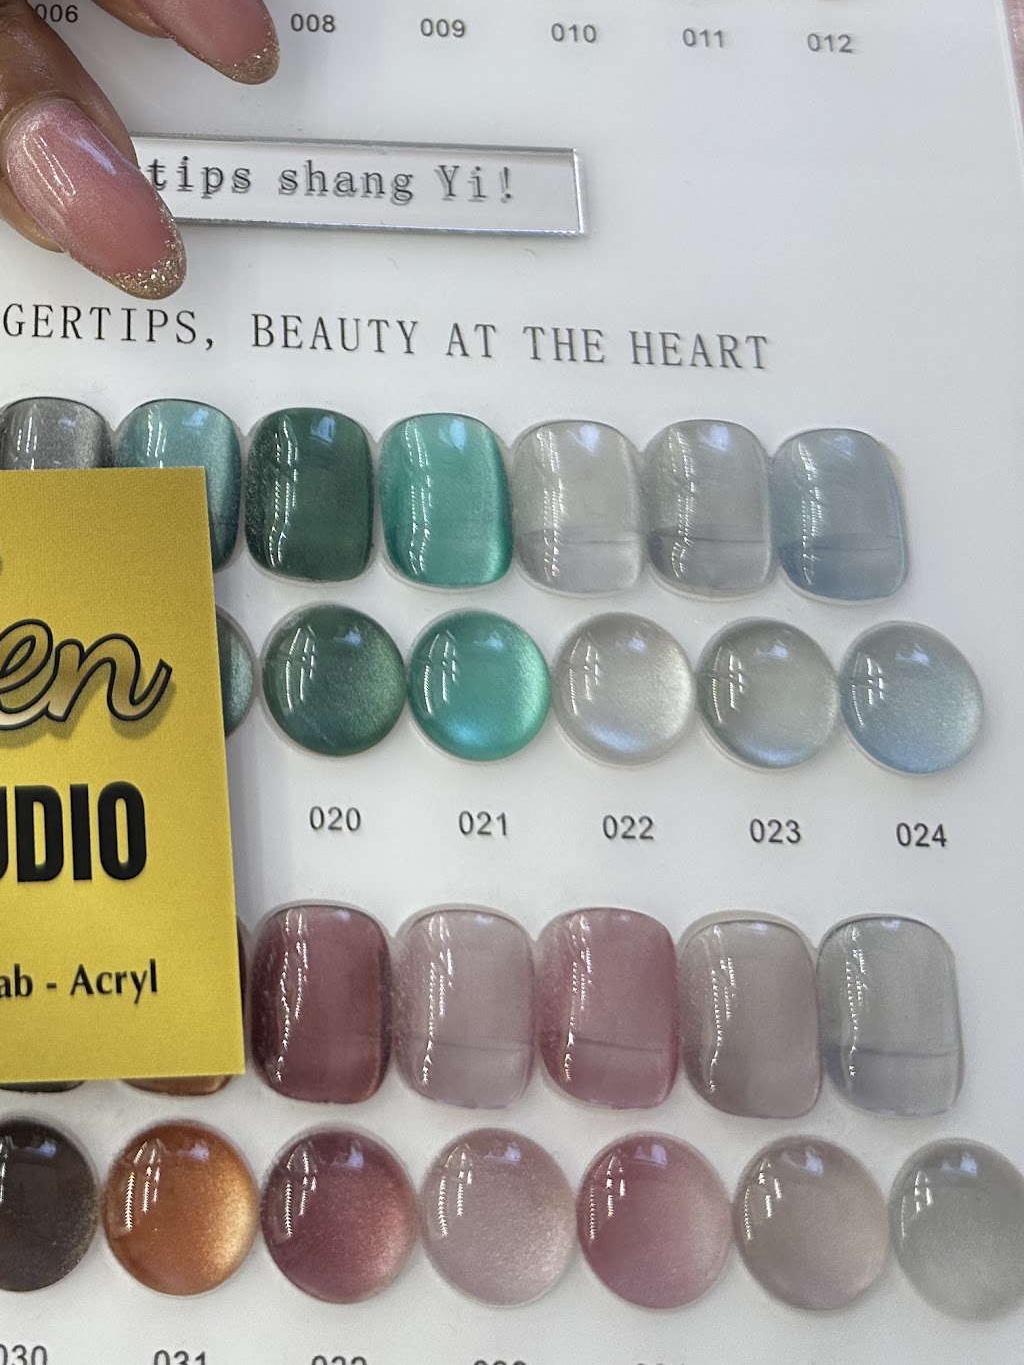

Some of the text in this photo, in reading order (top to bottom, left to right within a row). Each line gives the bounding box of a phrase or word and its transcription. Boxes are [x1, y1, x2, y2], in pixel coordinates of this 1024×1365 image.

[35, 3, 79, 23] 006
[290, 12, 336, 33] 008
[420, 17, 466, 39] 009
[551, 22, 597, 44] 010
[682, 27, 724, 48] 011
[807, 32, 853, 54] 012
[279, 160, 414, 202] shang
[438, 163, 514, 202] Yi!
[251, 313, 419, 354] BEAUTY
[445, 322, 497, 359] AT
[522, 326, 606, 364] THE
[629, 330, 769, 370] HEART
[309, 806, 361, 832] 020
[458, 810, 508, 836] 021
[602, 814, 655, 841] 022
[749, 818, 802, 845] 023
[896, 822, 948, 848] 024
[69, 958, 159, 1005] Acryl
